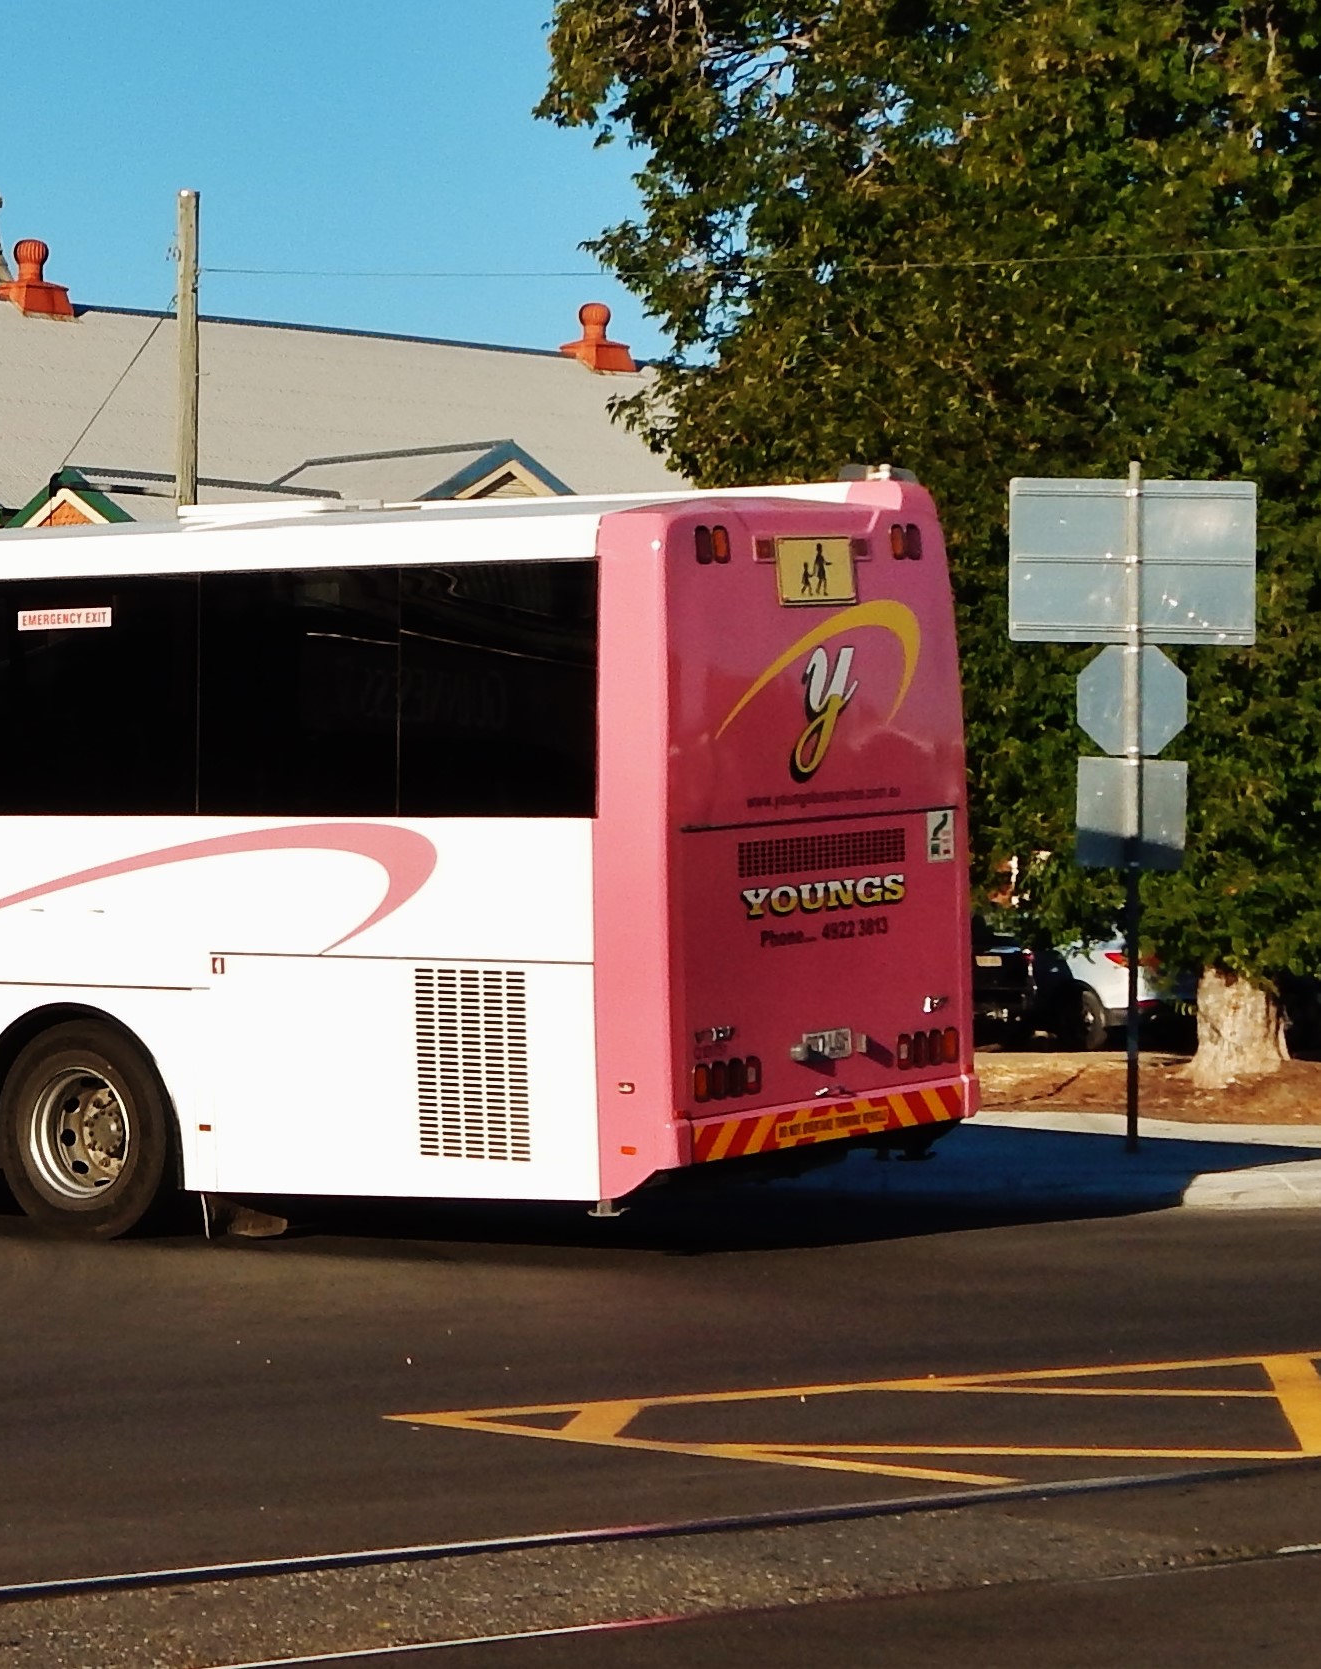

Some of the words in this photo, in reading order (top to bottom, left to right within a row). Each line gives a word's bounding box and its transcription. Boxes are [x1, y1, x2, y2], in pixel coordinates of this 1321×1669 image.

[22, 612, 83, 627] EMERGENCY
[85, 611, 107, 624] EXIT
[741, 873, 907, 920] YOUNGS
[822, 920, 856, 939] 4922
